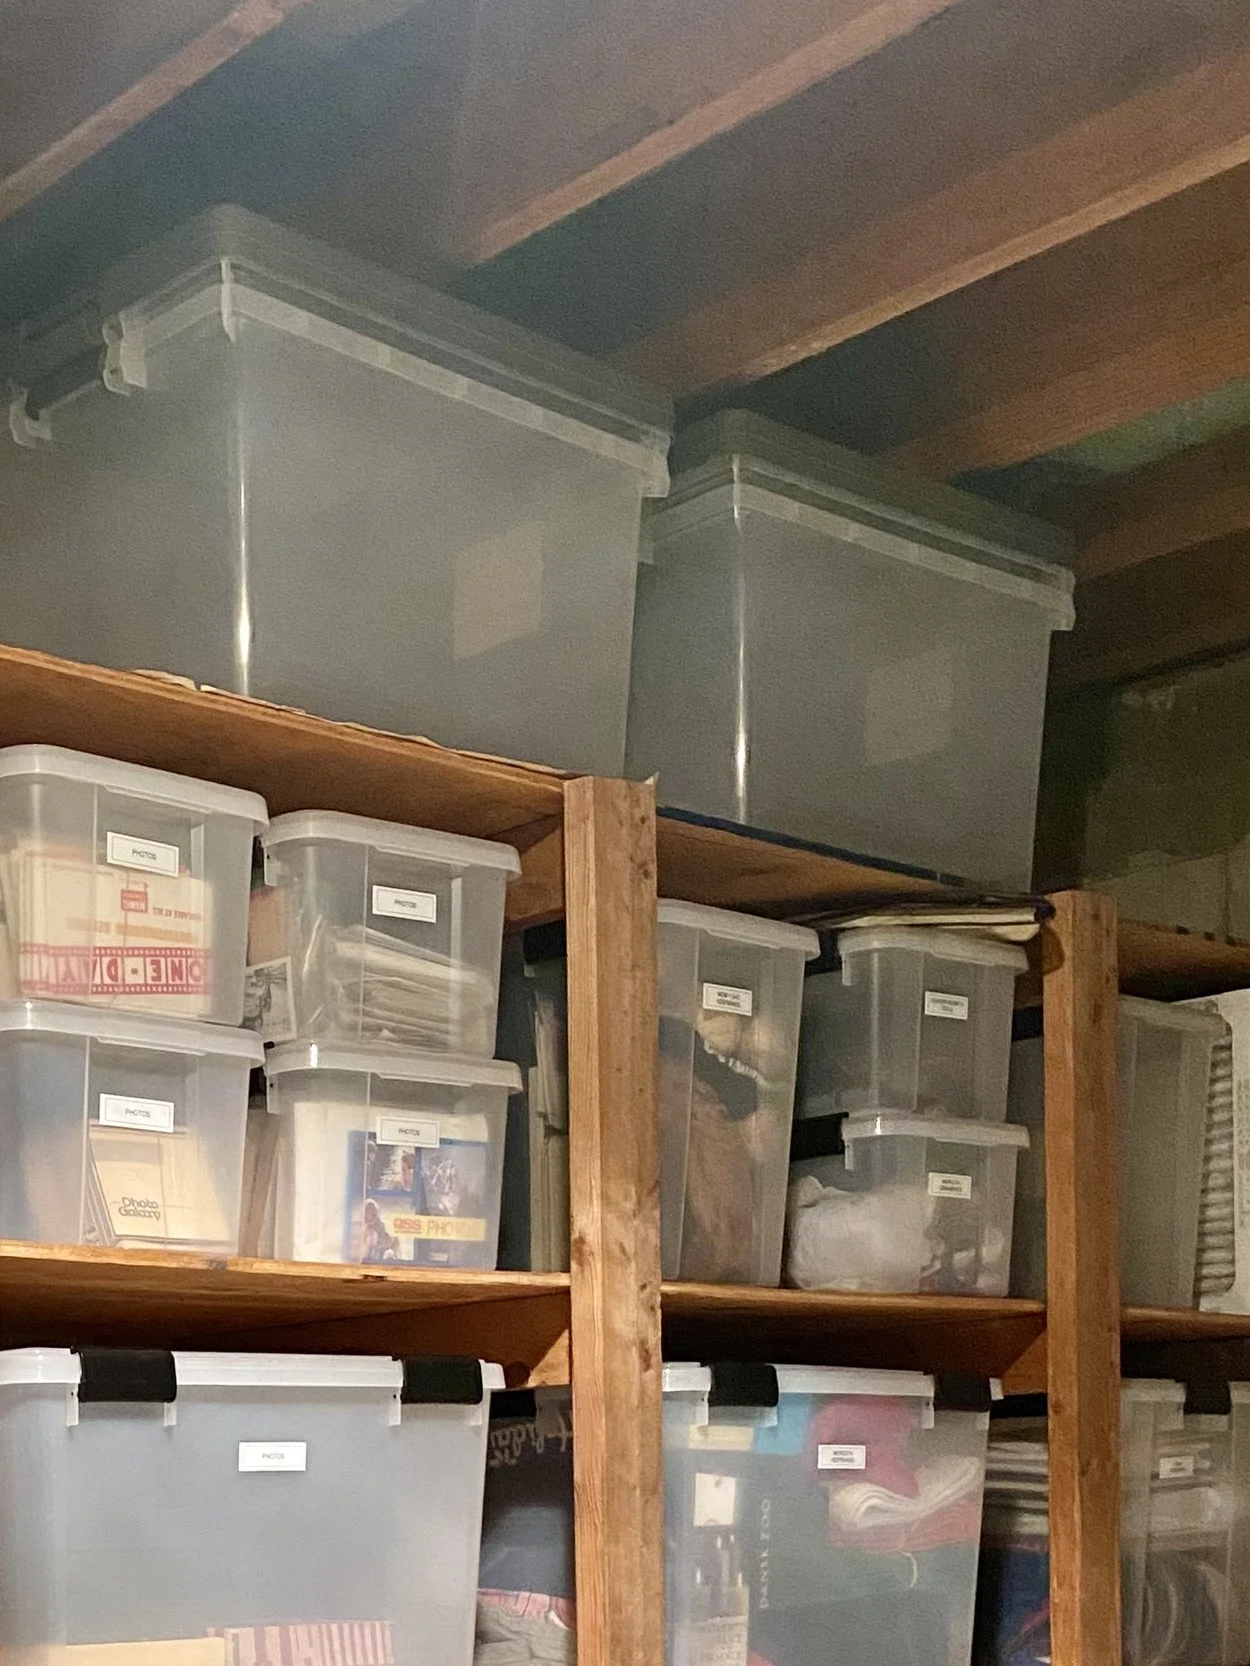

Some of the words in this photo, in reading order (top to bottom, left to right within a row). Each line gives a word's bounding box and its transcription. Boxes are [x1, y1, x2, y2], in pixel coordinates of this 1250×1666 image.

[131, 848, 157, 861] PHOTOS
[125, 1108, 151, 1119] PHOTOS
[398, 1127, 421, 1137] PHOTOS
[121, 1196, 159, 1209] Photo
[118, 1206, 161, 1222] Galaxy
